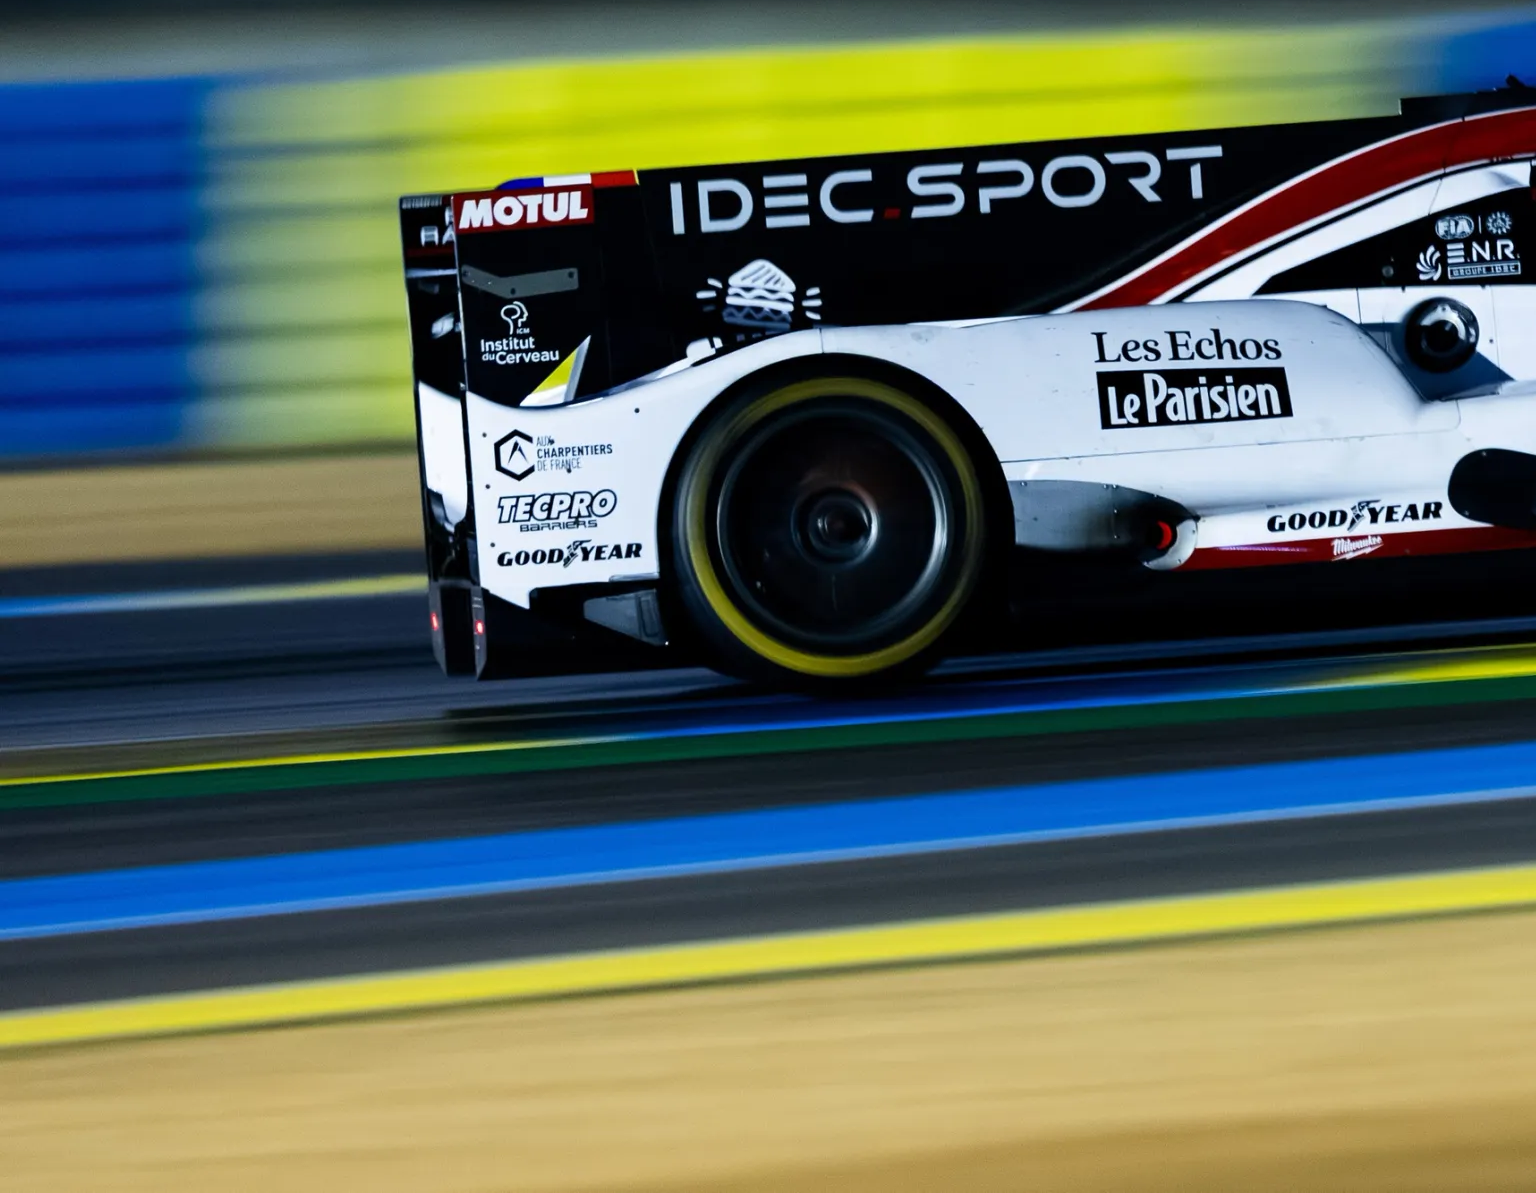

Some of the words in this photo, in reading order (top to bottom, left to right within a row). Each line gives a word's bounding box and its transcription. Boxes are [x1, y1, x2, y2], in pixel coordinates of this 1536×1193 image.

[458, 191, 589, 229] MOTUL
[1437, 218, 1471, 236] FIA
[481, 337, 536, 353] Institut
[496, 350, 560, 365] Cerveau
[1091, 332, 1162, 363] Les
[1164, 328, 1282, 361] Echos
[1107, 386, 1141, 425] Le
[1143, 372, 1282, 424] Parisien
[537, 444, 613, 459] CHARPENTIERS
[498, 489, 618, 524] TECPRO
[1267, 500, 1443, 534] GOODYEAR
[497, 539, 643, 568] GOODYEAR
